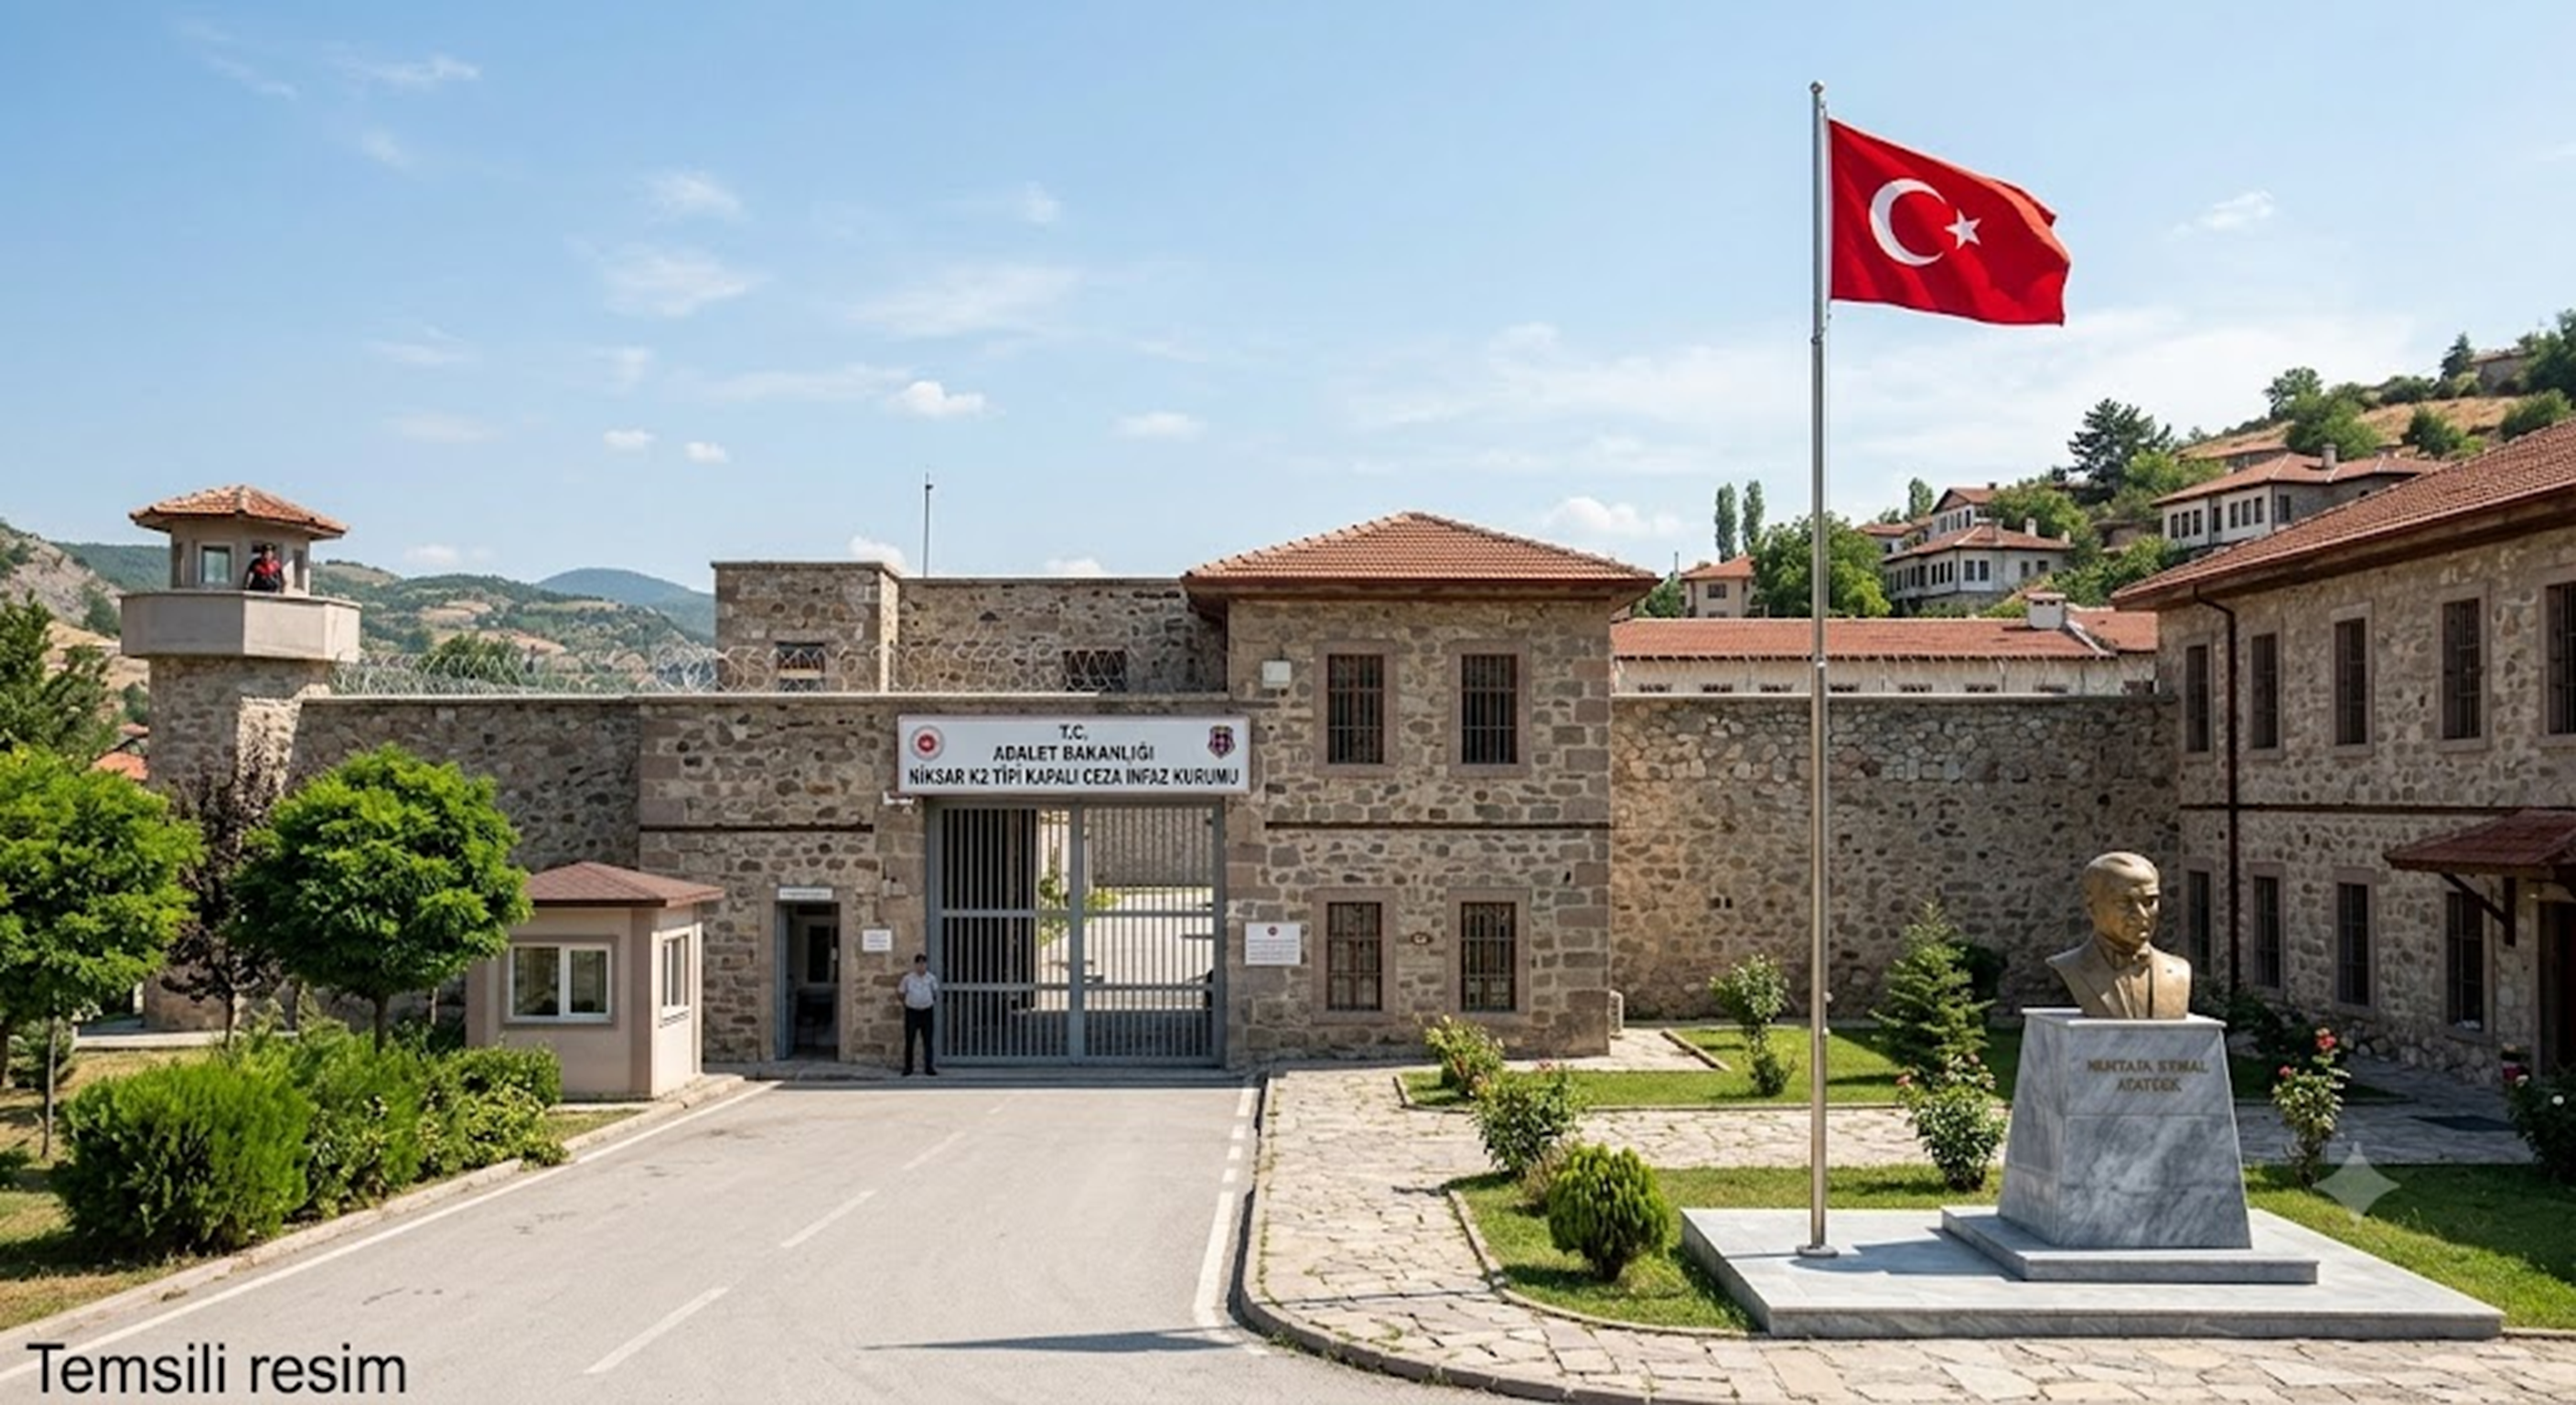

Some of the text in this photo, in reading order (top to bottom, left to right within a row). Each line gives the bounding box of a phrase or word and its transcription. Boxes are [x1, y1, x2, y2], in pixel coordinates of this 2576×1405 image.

[993, 742, 1154, 761] ADALET BAKANLIĞI
[908, 764, 965, 785] NİKSAR
[970, 767, 989, 785] K2
[993, 762, 1022, 785] TİPİ
[1025, 767, 1078, 785] KAPALI
[1083, 767, 1122, 785] CEZA
[1173, 767, 1240, 785] KURUMU
